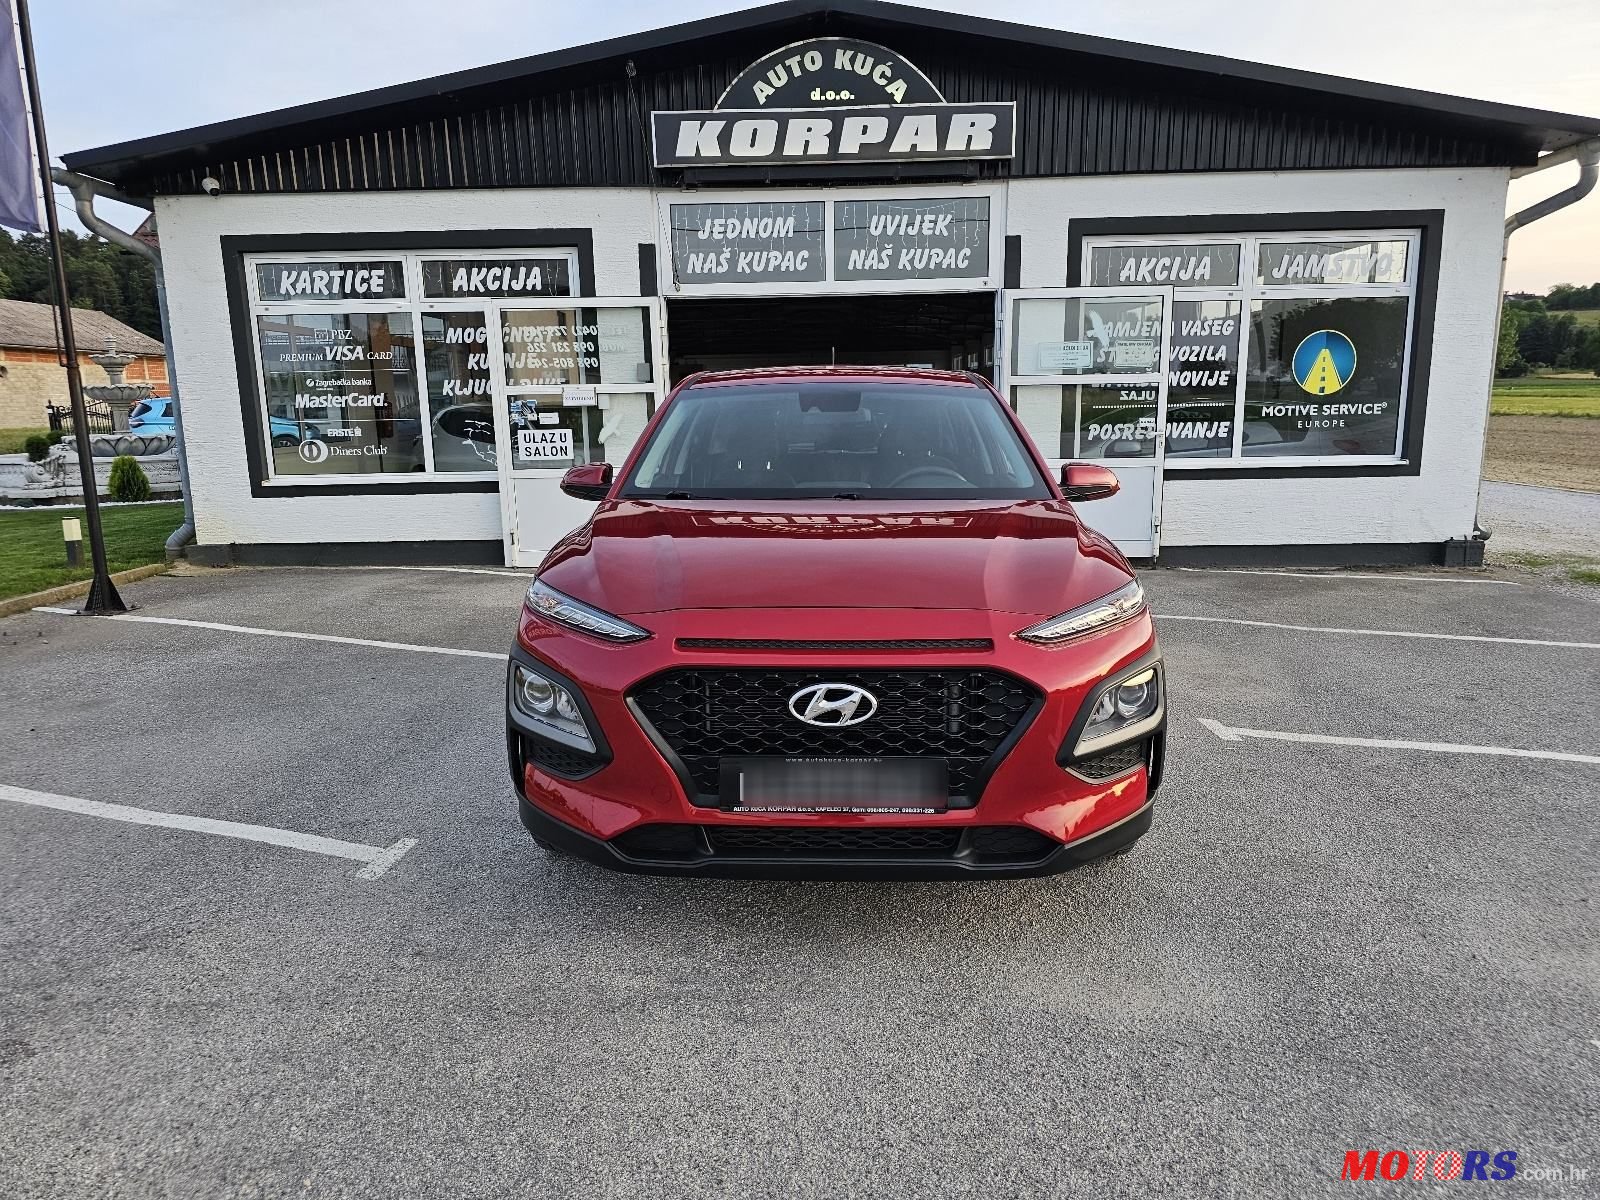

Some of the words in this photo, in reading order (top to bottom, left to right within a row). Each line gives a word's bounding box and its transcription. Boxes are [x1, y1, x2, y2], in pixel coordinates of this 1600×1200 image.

[752, 50, 823, 105] AUTO
[834, 48, 908, 104] KUĆA
[810, 87, 855, 101] d.o.o.
[675, 113, 997, 158] KORPAR
[698, 216, 795, 240] JEDNOM
[869, 213, 953, 237] UVIJEK
[687, 248, 731, 275] NAŠ
[736, 249, 809, 274] KUPAC
[848, 244, 893, 270] NAŠ
[898, 247, 971, 270] KUPAC
[1271, 252, 1393, 279] JAMSTVO
[1119, 256, 1211, 283] AKCIJA
[279, 269, 385, 296] KARTICE
[452, 266, 542, 292] AKCIJA
[331, 329, 353, 340] PBZ
[280, 353, 324, 362] PREMIUM
[324, 345, 365, 361] VISA
[367, 351, 393, 360] CARD
[1169, 344, 1227, 362] VOZILA
[352, 377, 372, 386] banka
[1168, 370, 1231, 387] NOVIJE
[1261, 404, 1319, 417] MOTIVE
[327, 428, 354, 437] ERSTE
[1297, 419, 1345, 429] EUROPE
[523, 432, 557, 443] ULAZ
[559, 432, 567, 443] U
[330, 446, 362, 456] Diners
[524, 445, 568, 457] SALON
